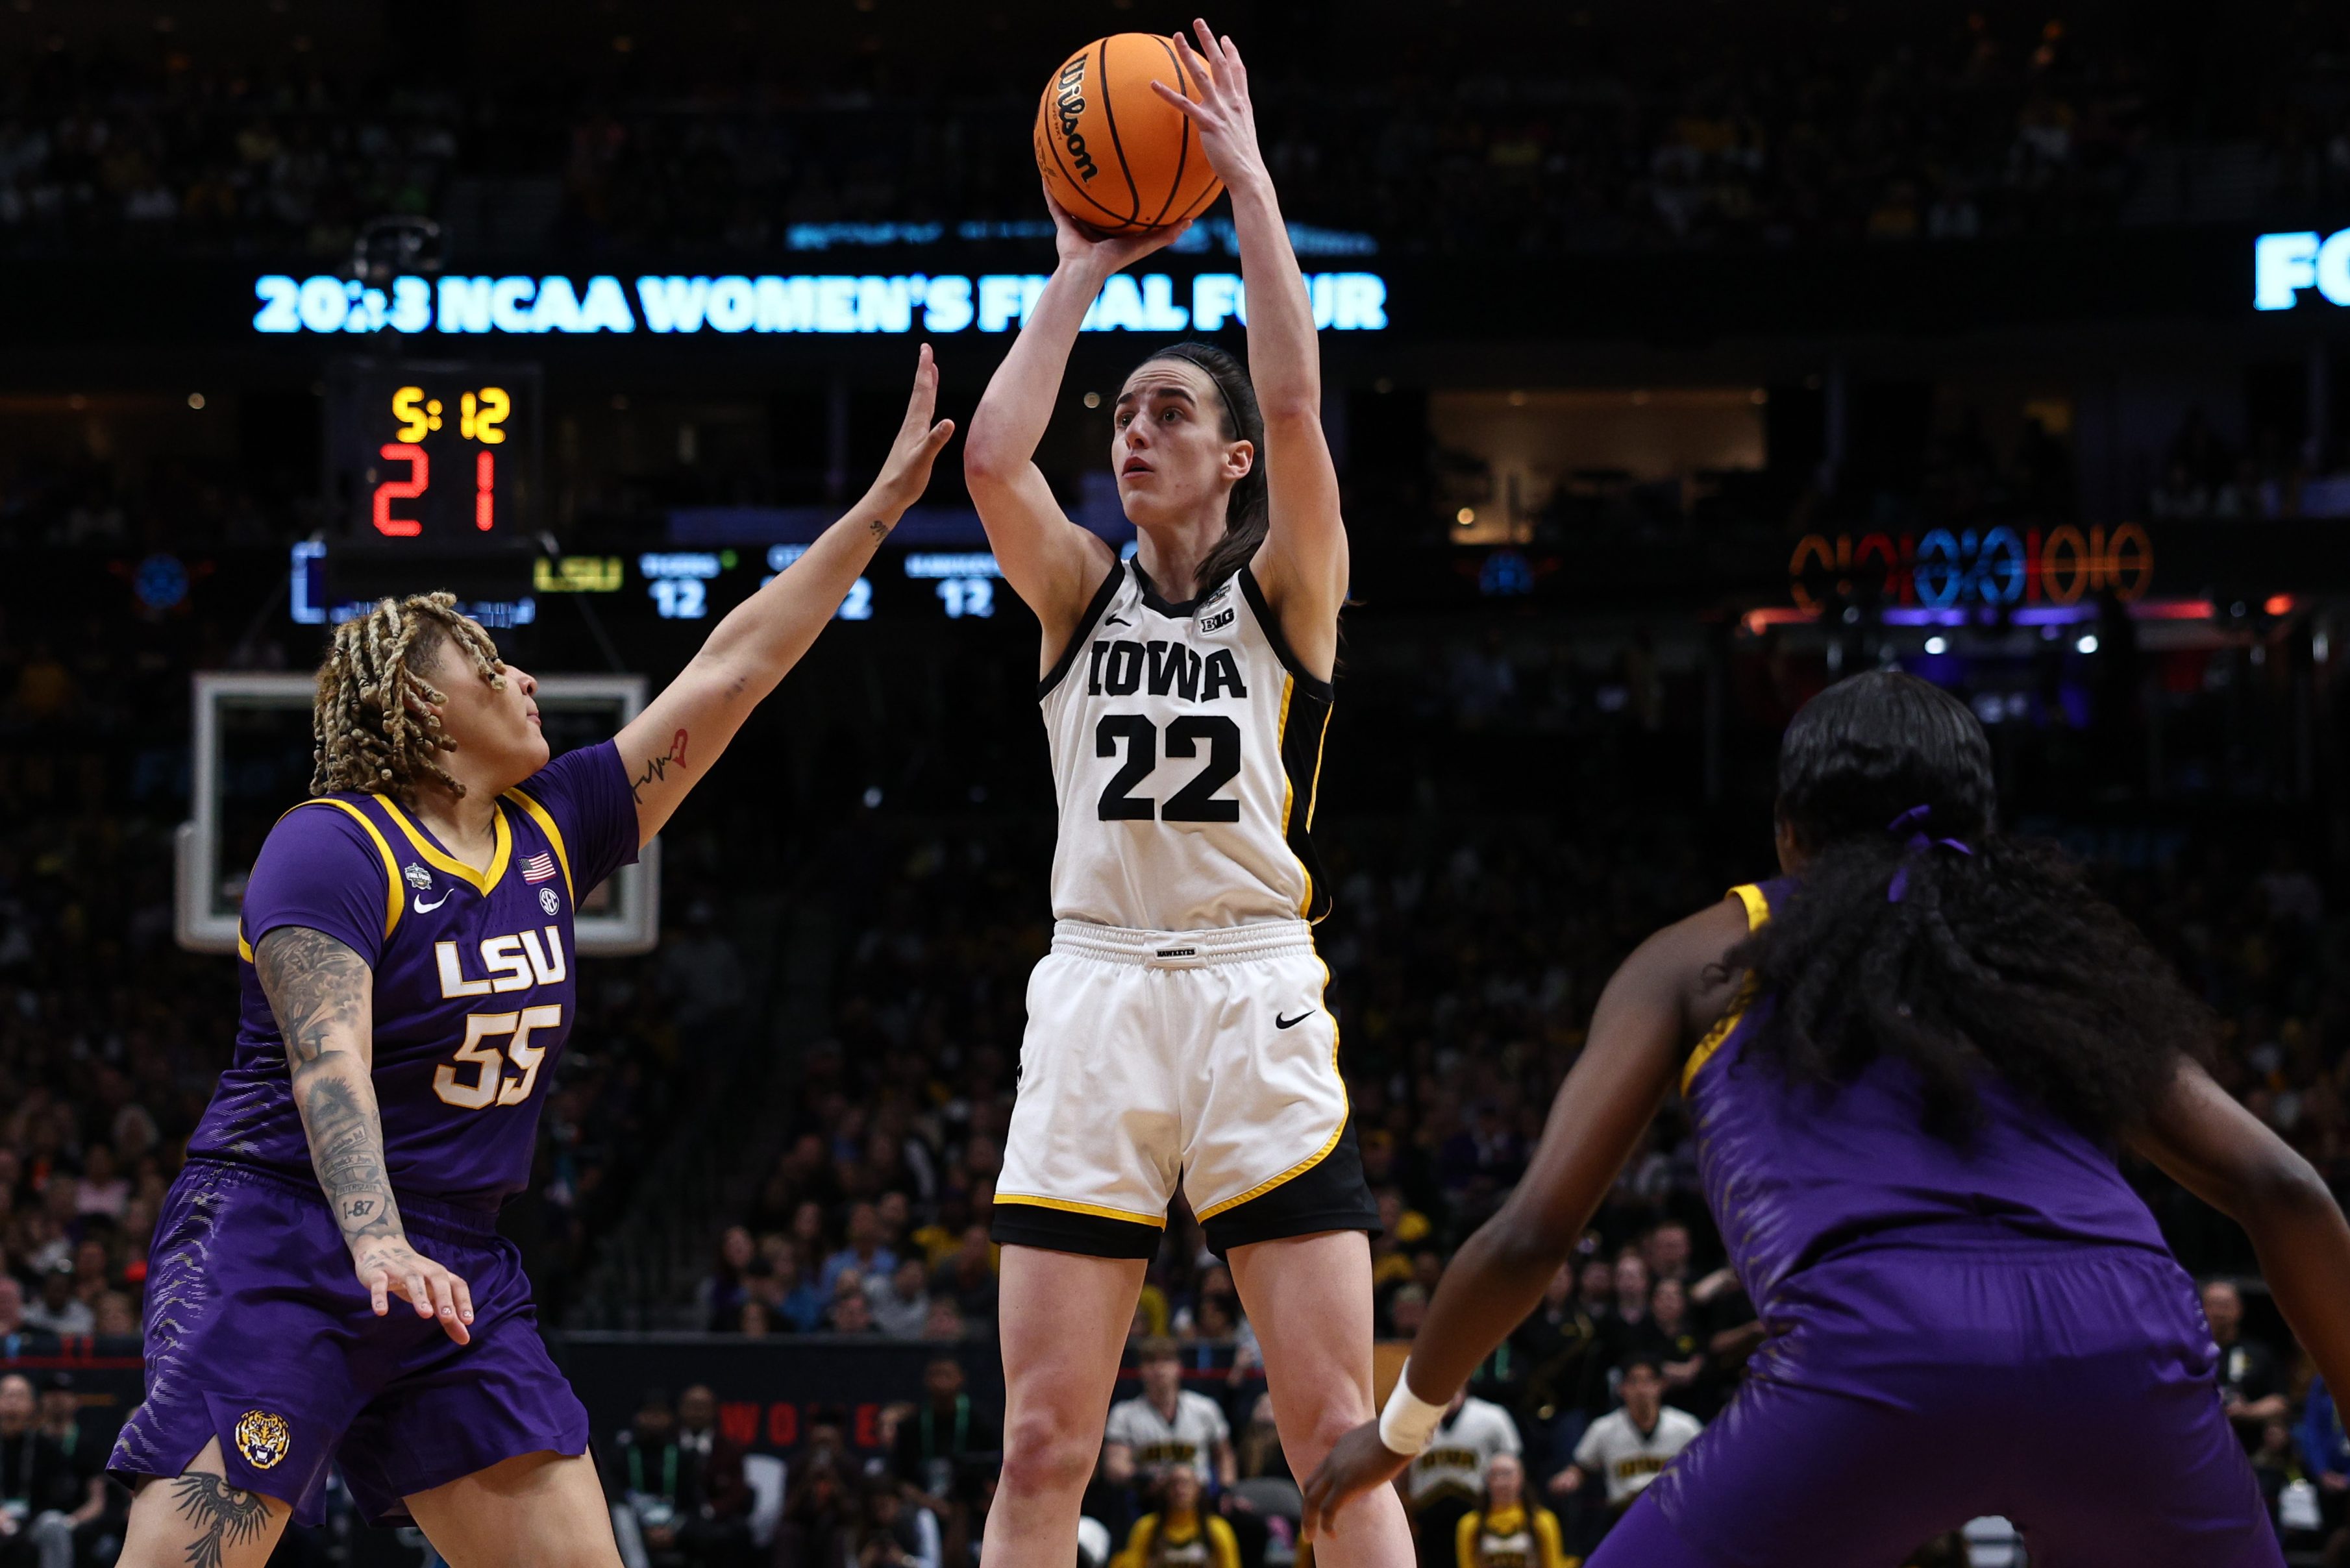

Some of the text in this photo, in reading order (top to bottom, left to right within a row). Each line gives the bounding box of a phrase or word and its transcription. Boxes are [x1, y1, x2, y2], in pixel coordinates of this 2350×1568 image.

[1056, 53, 1098, 184] Wilson
[436, 275, 636, 333] NCAA
[635, 273, 973, 333] WOMEN'S
[978, 274, 1189, 332] FIAL
[1192, 273, 1388, 330] FUR
[391, 386, 511, 444] 5:12
[532, 554, 625, 593] LSU
[1088, 641, 1247, 703] IOWA
[1096, 714, 1241, 822] 22
[541, 890, 558, 913] SEC
[434, 925, 567, 999] LSU
[1157, 949, 1195, 957] HAWKEYES
[432, 1003, 562, 1110] 55
